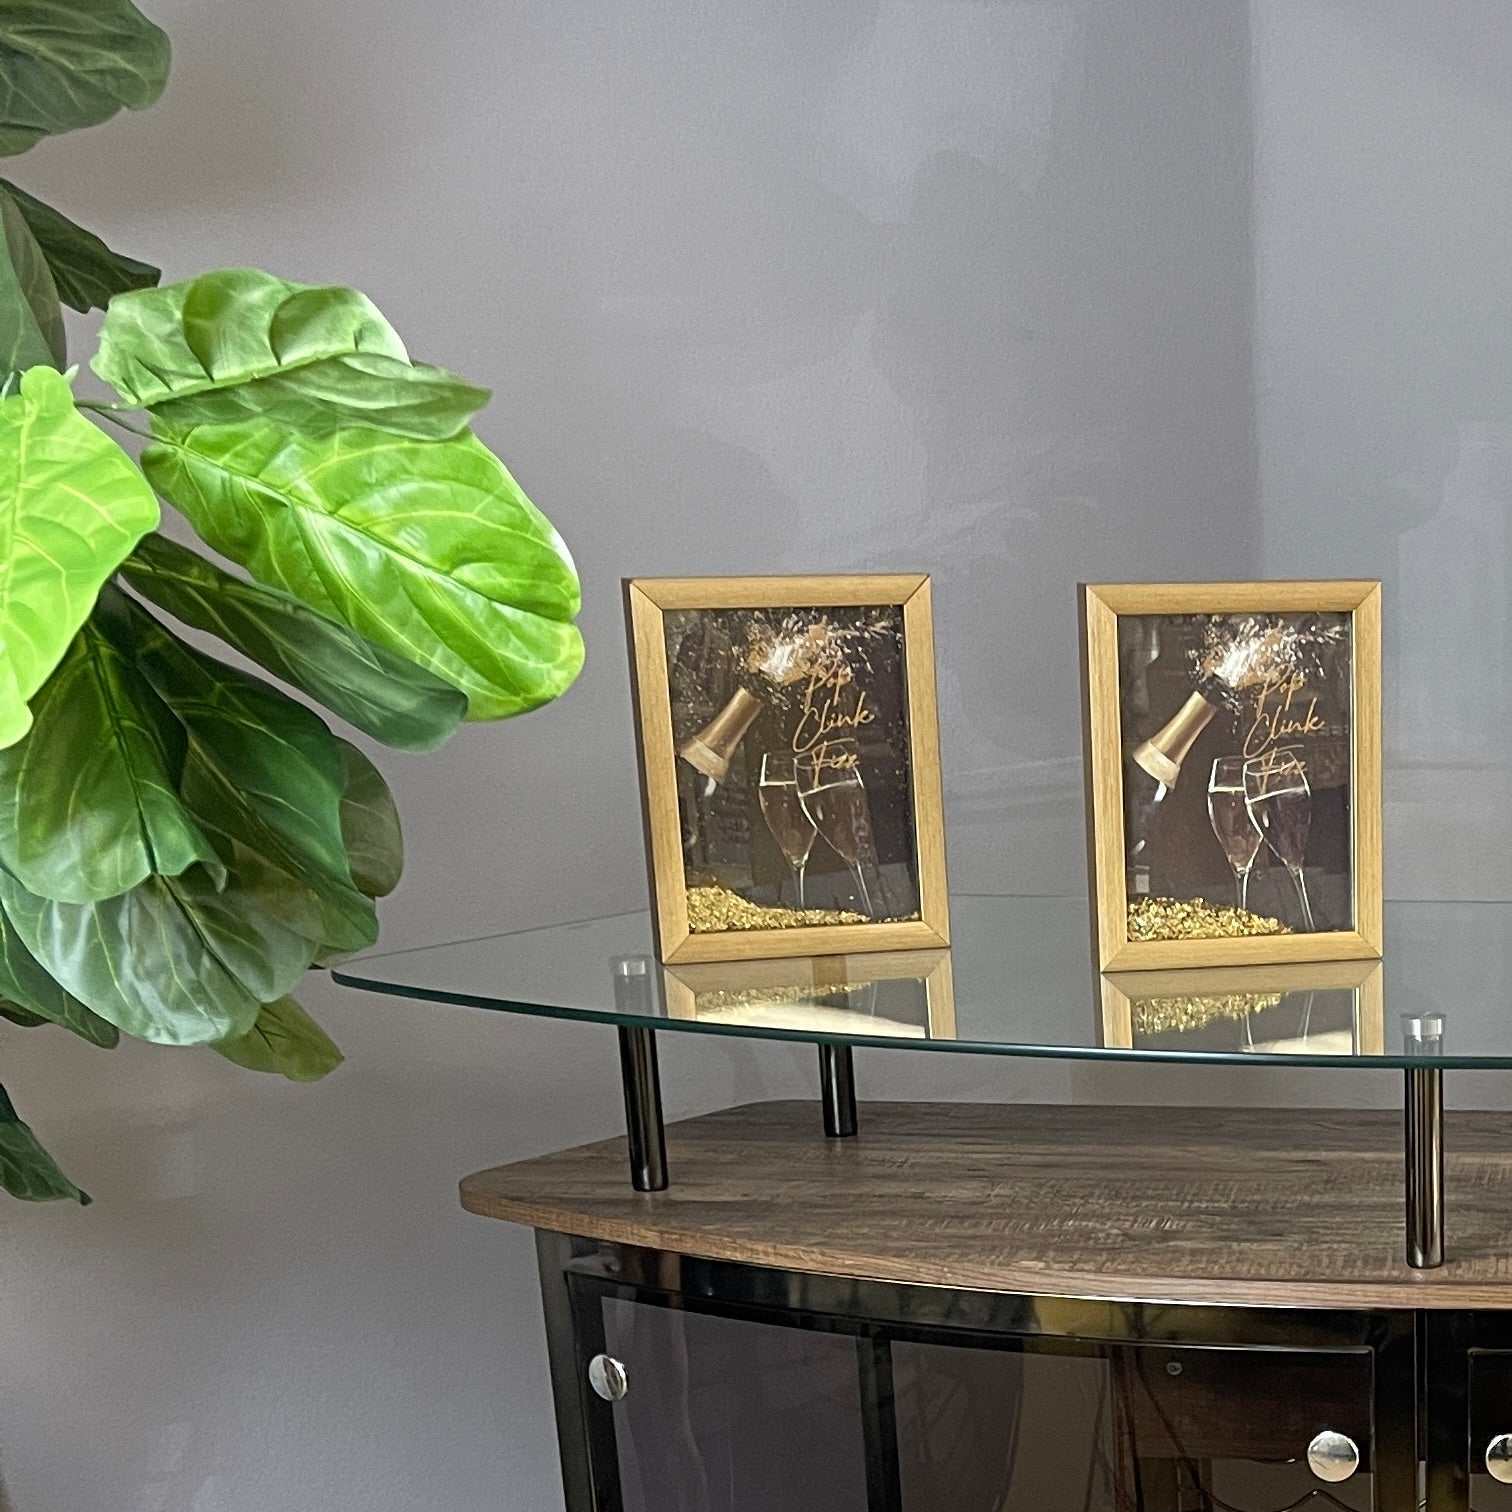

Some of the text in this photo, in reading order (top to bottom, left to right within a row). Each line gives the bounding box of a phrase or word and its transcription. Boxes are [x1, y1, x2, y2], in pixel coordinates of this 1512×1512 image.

[793, 691, 875, 752] Clink
[1256, 663, 1306, 719] Pop
[1243, 697, 1325, 758] Clink
